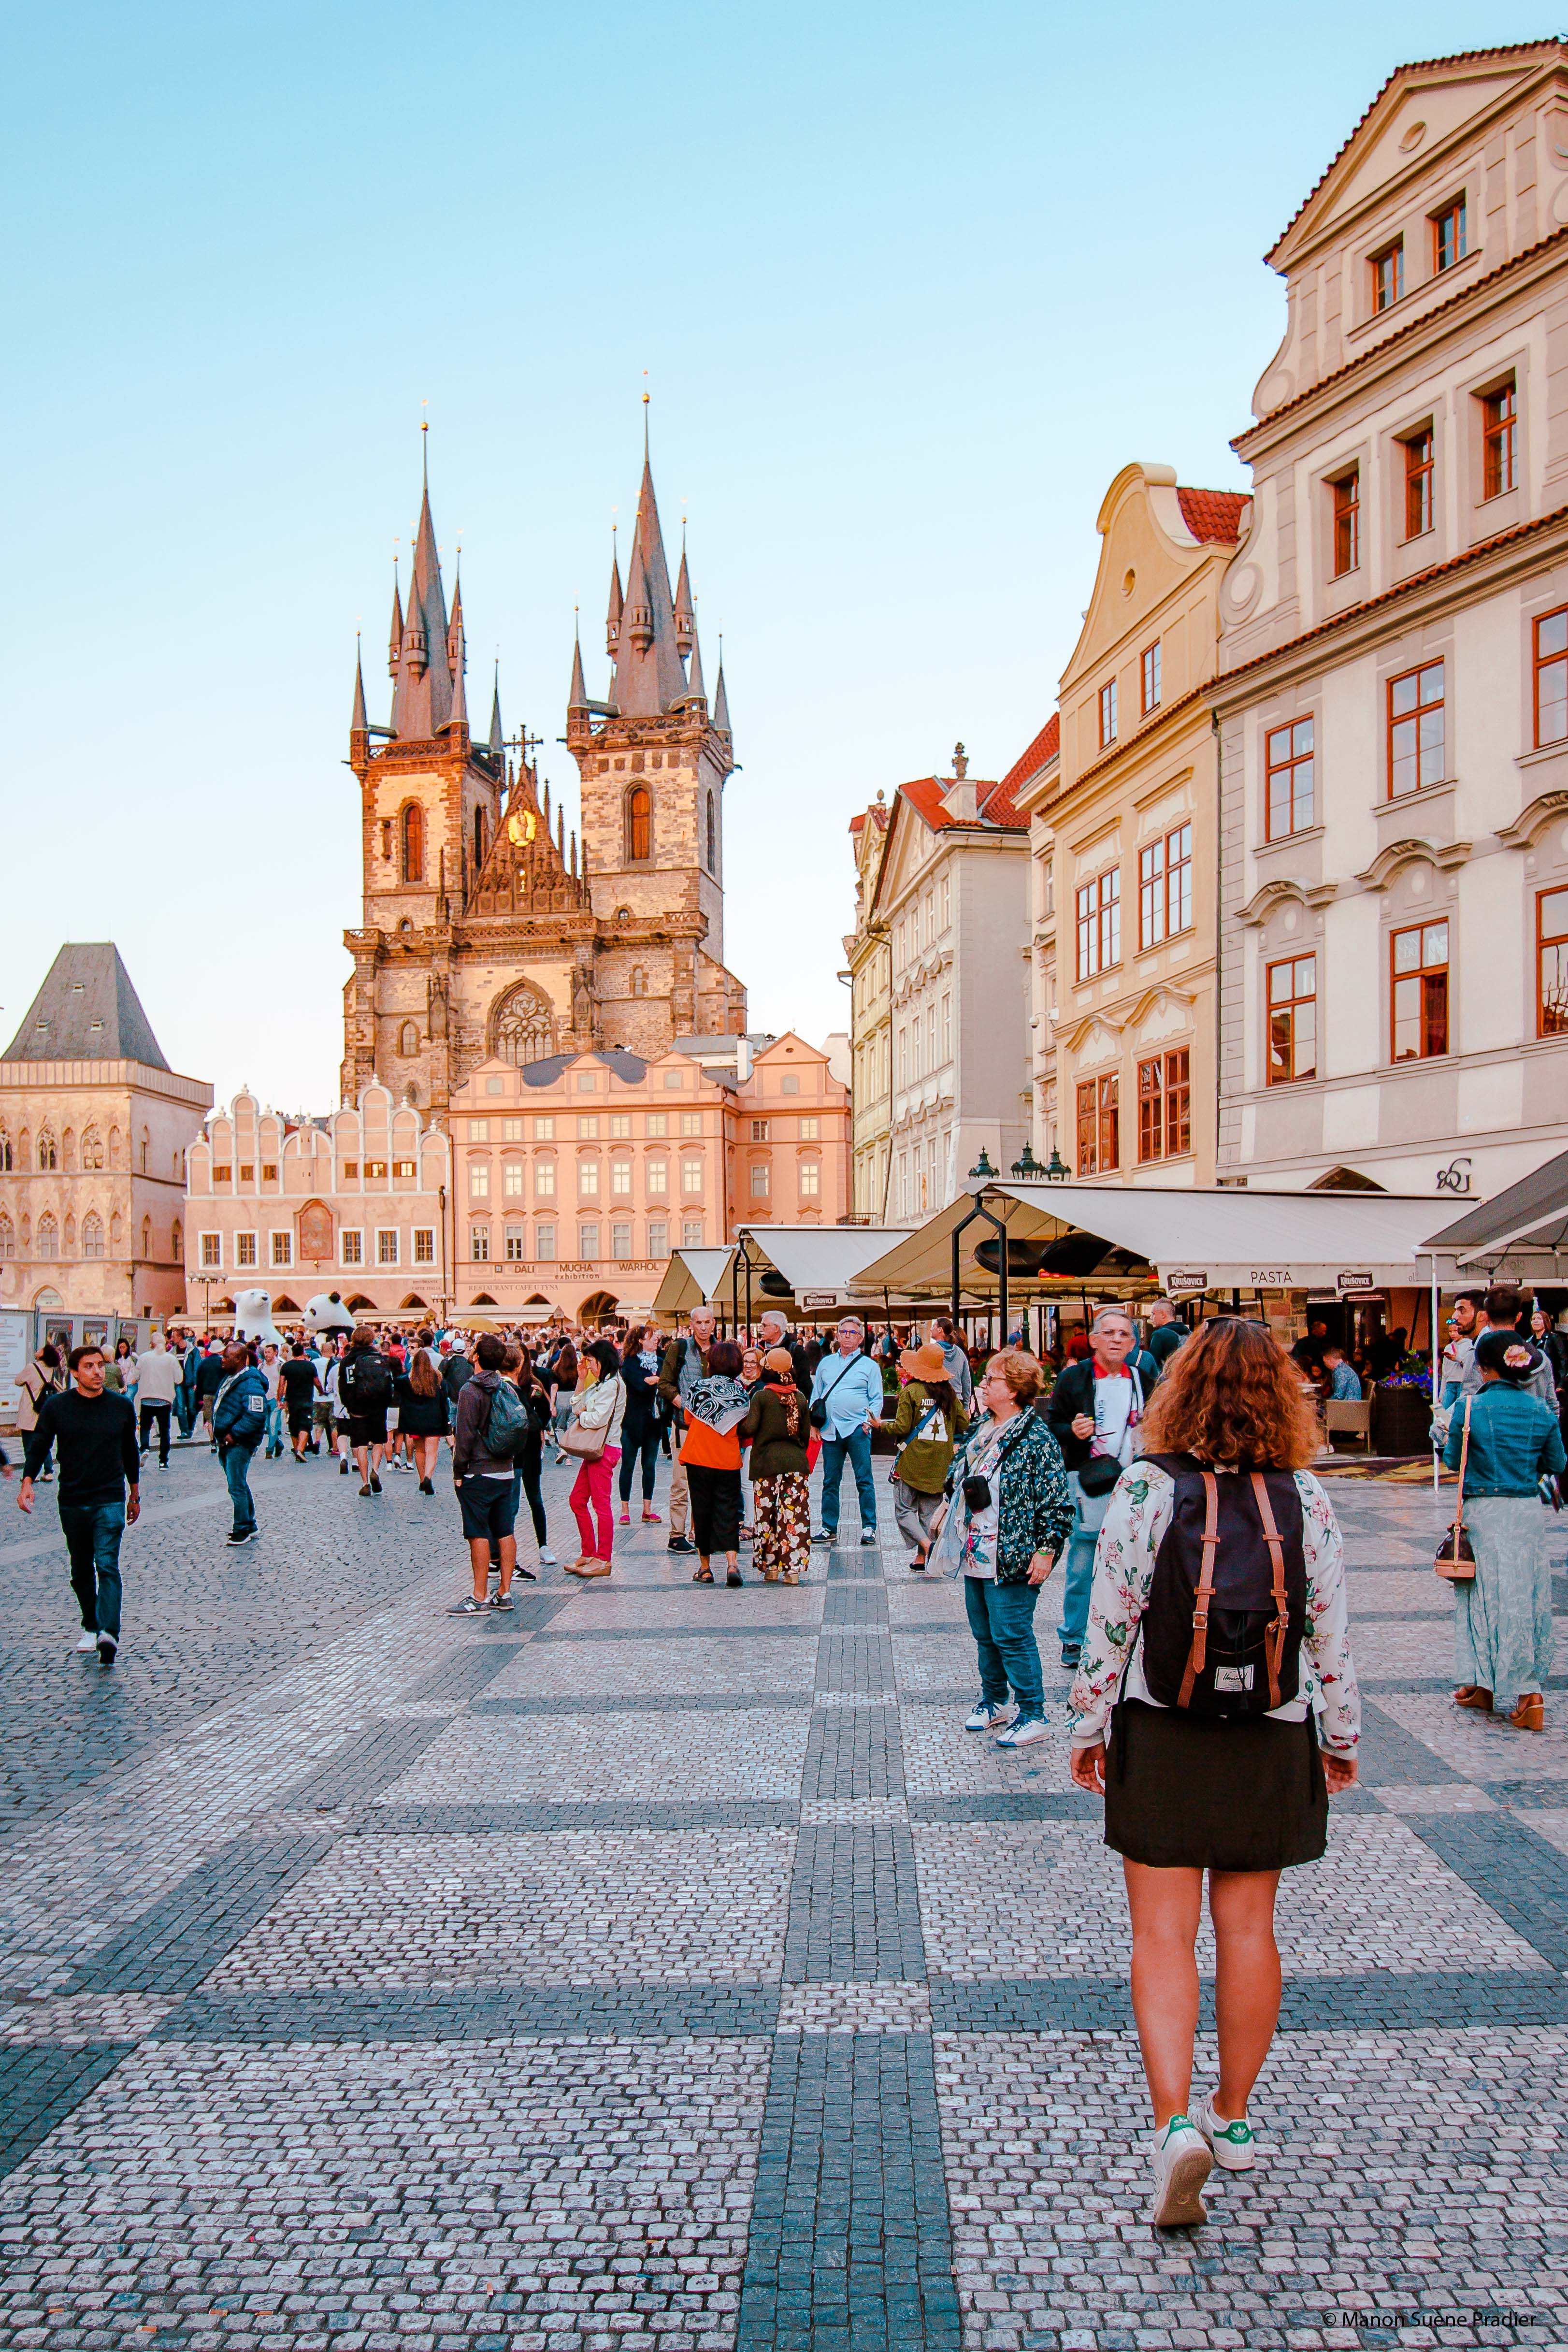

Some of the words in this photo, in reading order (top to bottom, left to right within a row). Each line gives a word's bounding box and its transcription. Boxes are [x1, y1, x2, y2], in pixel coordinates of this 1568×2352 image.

[560, 1264, 593, 1272] MUCHA
[619, 1262, 658, 1271] WARHOL
[1251, 1271, 1293, 1283] PASTA
